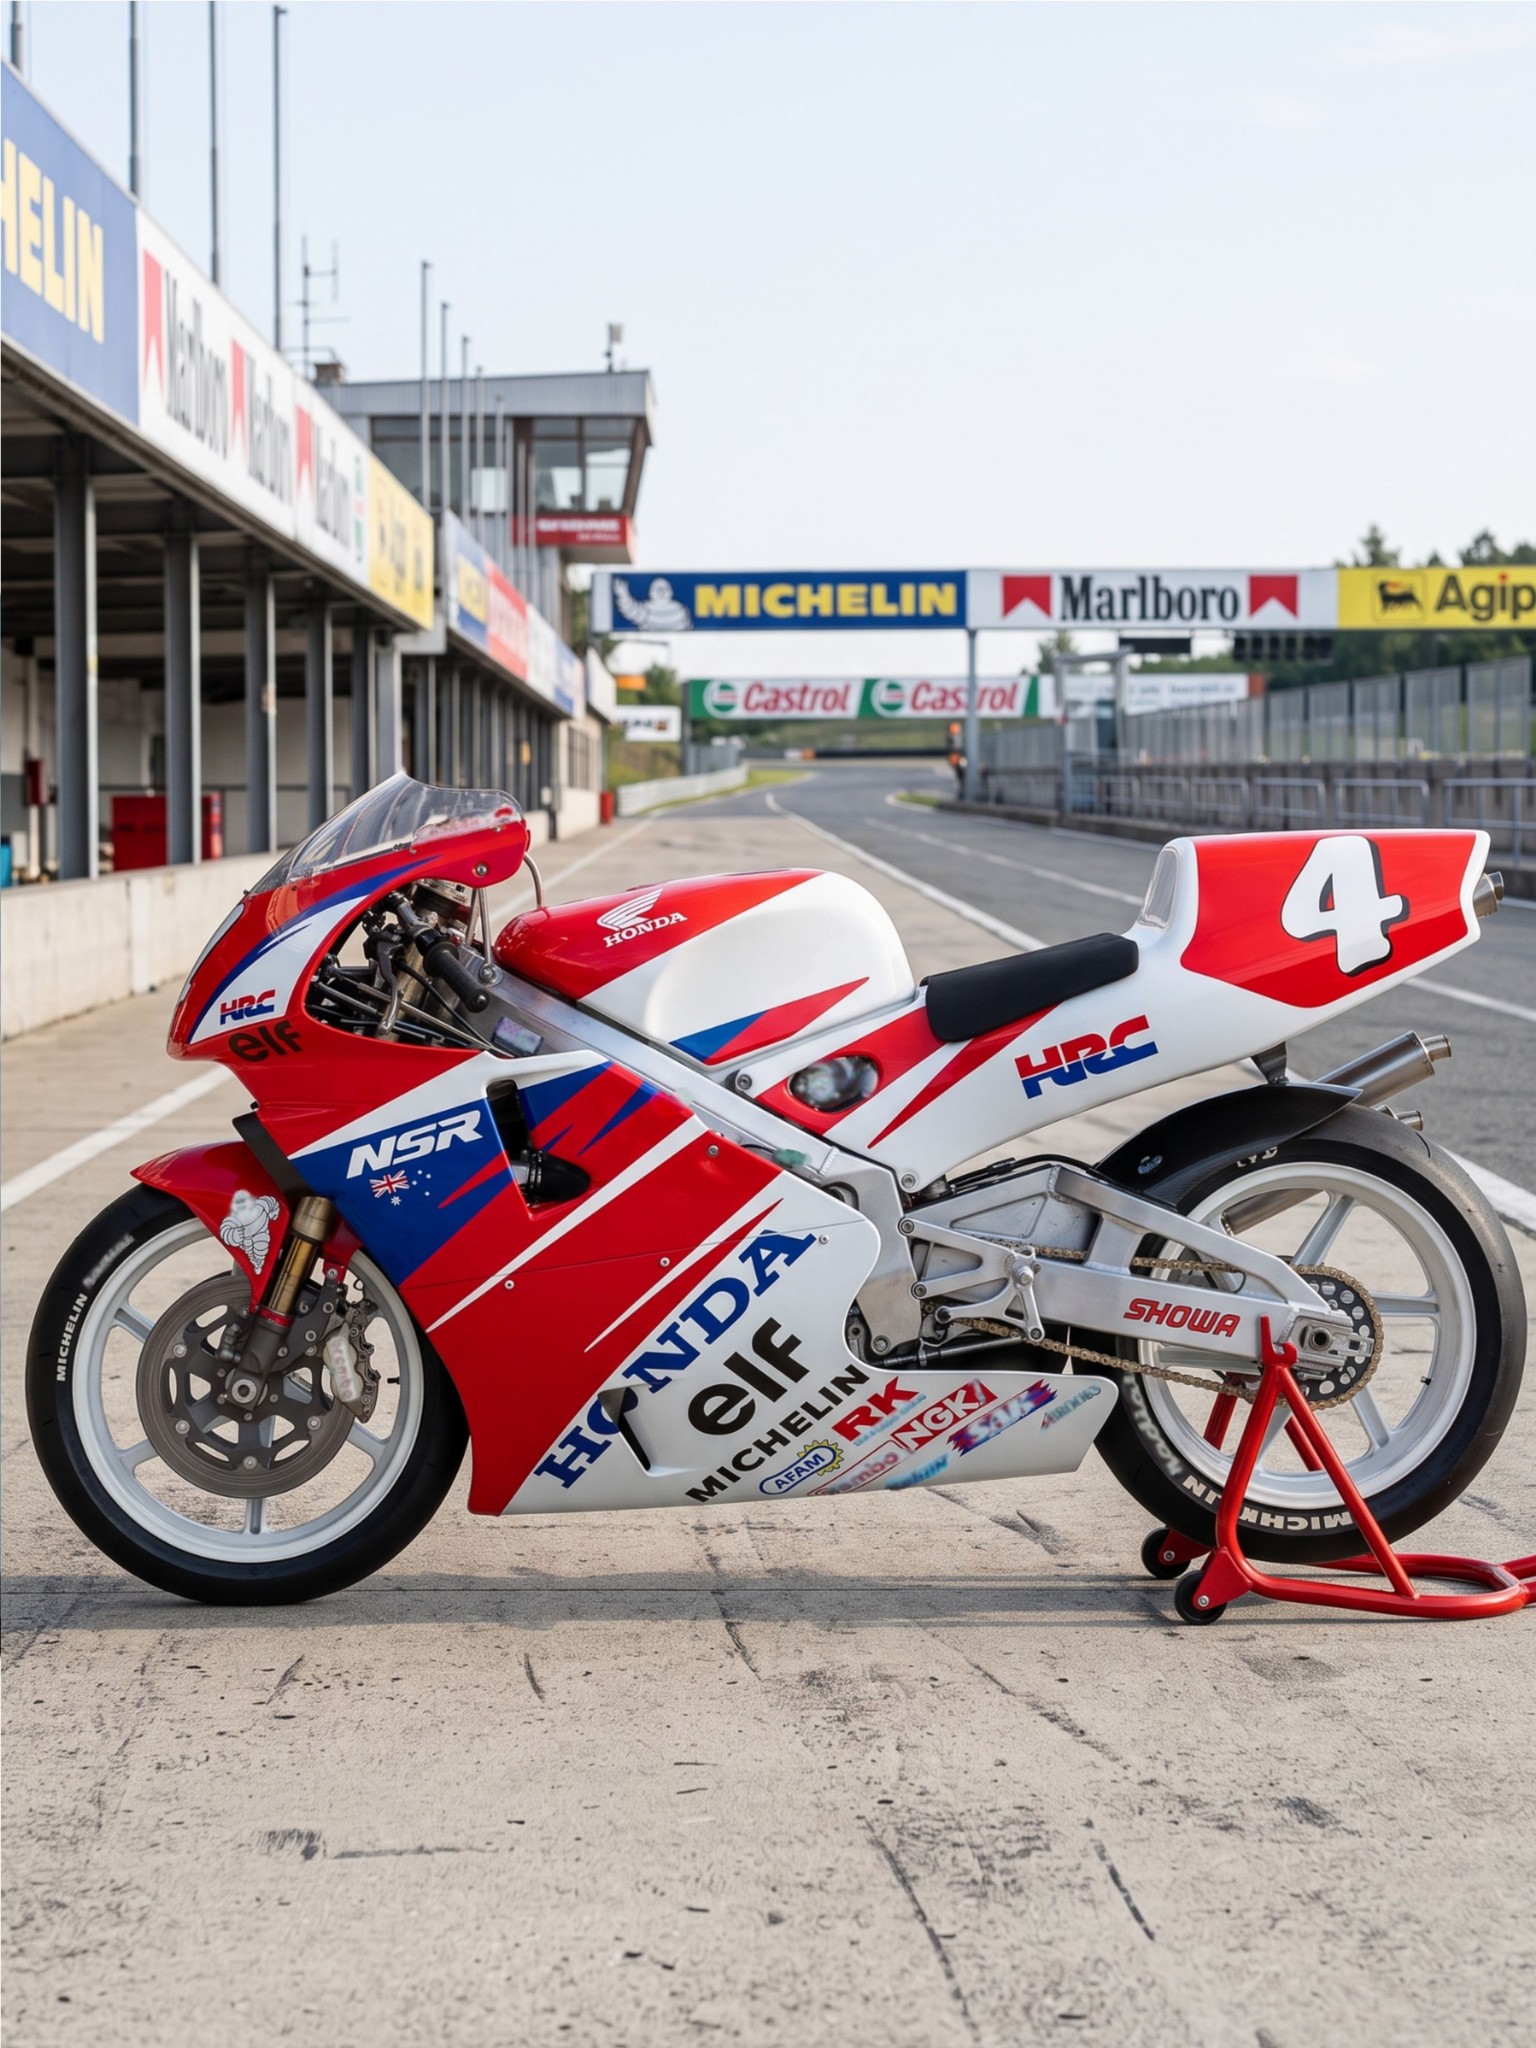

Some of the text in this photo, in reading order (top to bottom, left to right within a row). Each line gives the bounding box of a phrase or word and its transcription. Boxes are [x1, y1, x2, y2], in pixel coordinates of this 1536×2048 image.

[694, 583, 957, 618] MICHELIN
[1060, 575, 1240, 622] Marlboro
[1435, 572, 1536, 622] Agip
[743, 681, 851, 713] Castrol
[911, 681, 1018, 713] Casrol
[603, 912, 688, 948] HONDA
[1281, 835, 1410, 977] 4
[220, 989, 276, 1025] HRC
[229, 1020, 302, 1062] elf
[1014, 1014, 1158, 1099] HRC
[346, 1110, 483, 1179] NSR
[56, 1293, 88, 1382] MICHELIN
[1123, 1298, 1241, 1337] SHOWA
[533, 1229, 817, 1489] HONDA
[688, 1317, 810, 1435] elf
[685, 1364, 870, 1503] MICHELIN
[832, 1376, 920, 1442] RK
[893, 1388, 980, 1452] NGK
[774, 1453, 825, 1490] AFAM
